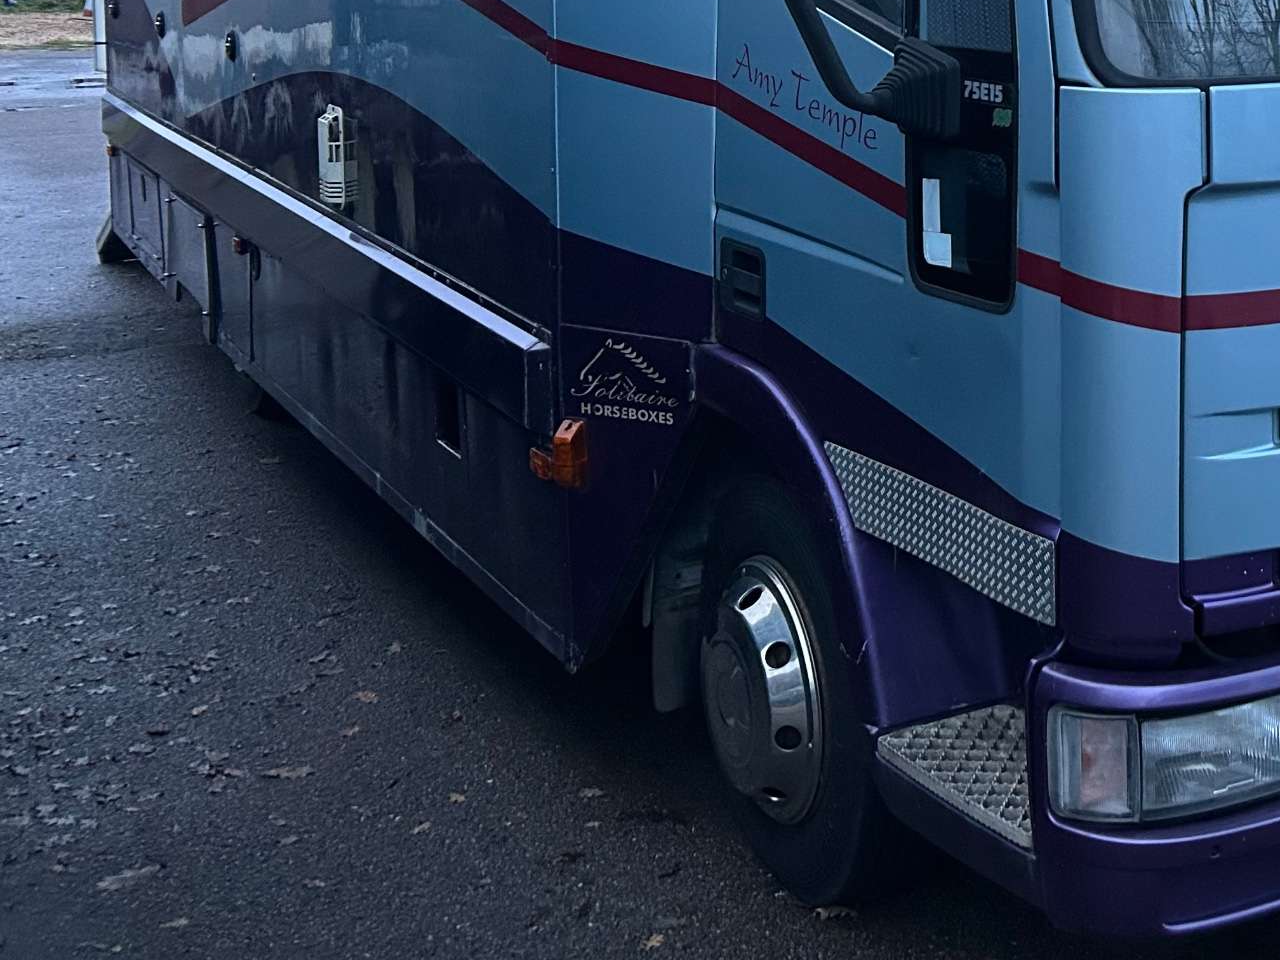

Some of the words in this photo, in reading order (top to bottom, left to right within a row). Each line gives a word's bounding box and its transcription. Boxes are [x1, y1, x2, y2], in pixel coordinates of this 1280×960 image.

[732, 43, 783, 108] Amy
[791, 69, 879, 151] Temple
[963, 80, 1004, 103] 75E15
[580, 402, 674, 425] HORSEBOXES
